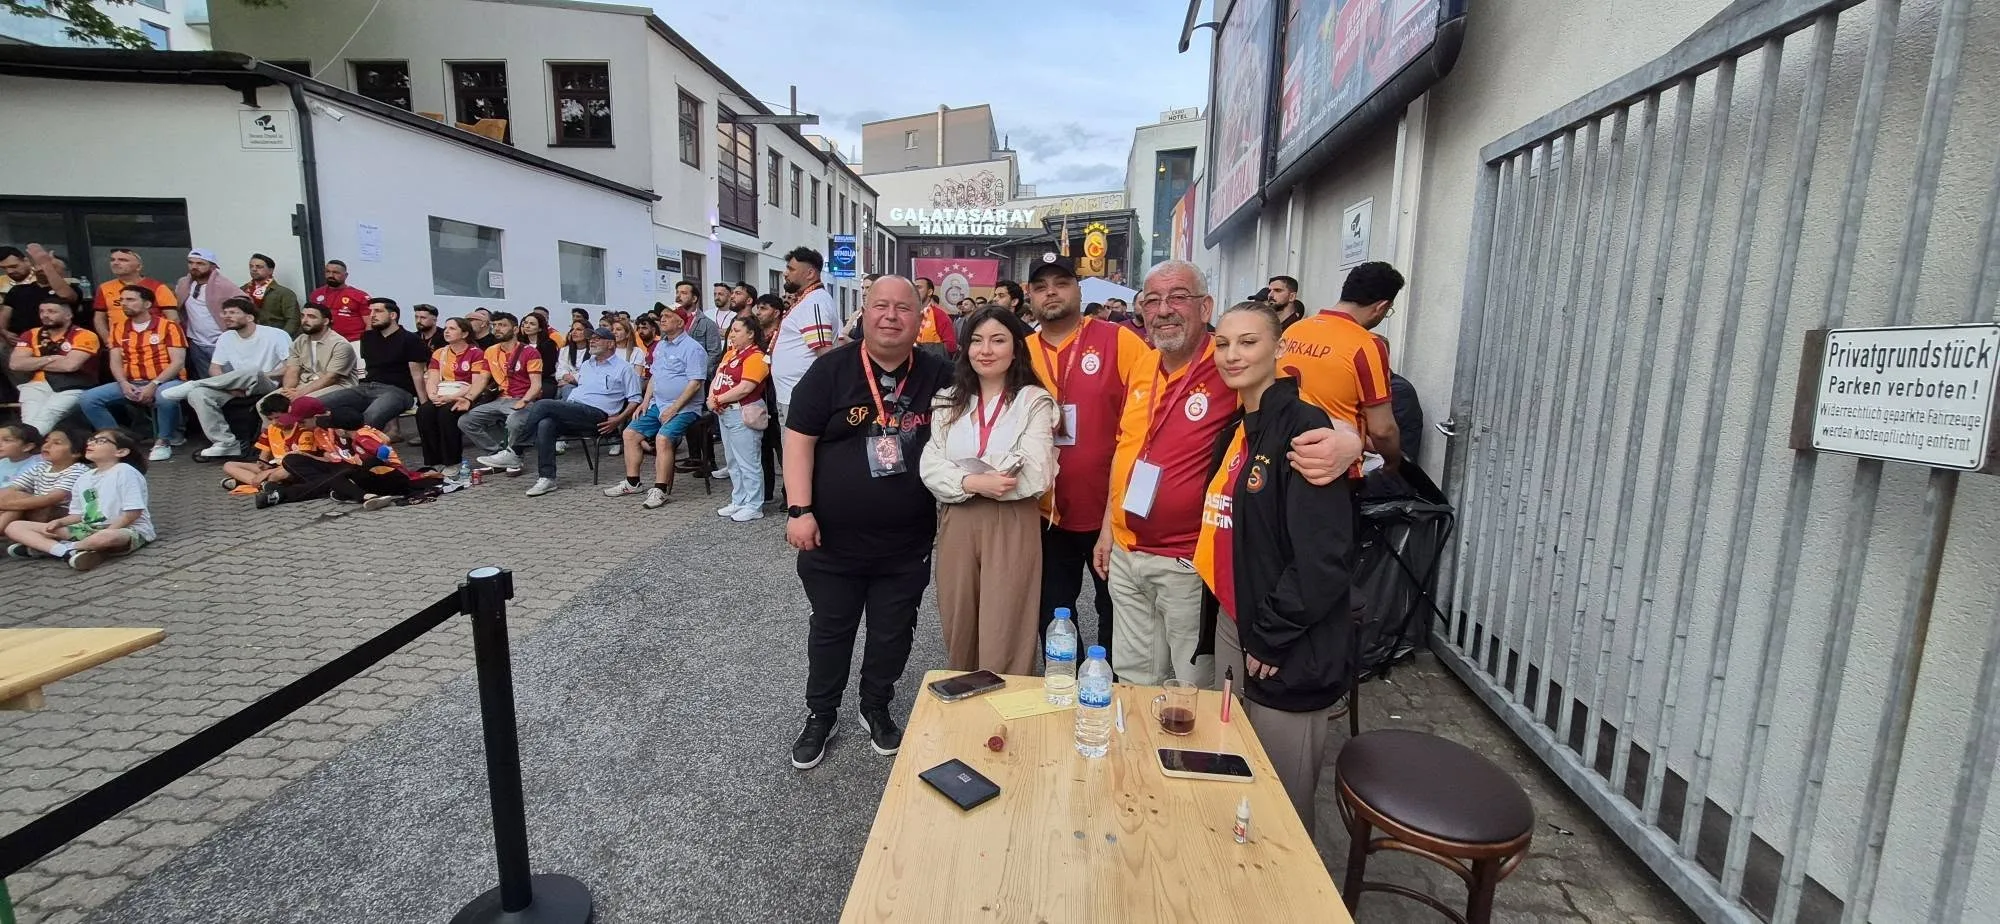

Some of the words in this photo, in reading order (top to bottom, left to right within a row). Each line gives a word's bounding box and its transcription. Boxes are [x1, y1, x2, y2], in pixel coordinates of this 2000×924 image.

[1168, 113, 1187, 121] HOTEL
[889, 207, 1036, 224] GALATASARAY
[919, 220, 1008, 236] HAMBURG
[1827, 338, 1992, 374] Privatgrundstück
[1828, 375, 1881, 396] Parken
[1820, 402, 1882, 420] Widerrechtlich
[1884, 408, 1925, 425] geparkte
[1927, 408, 1982, 431] Fahrzeuge
[1822, 425, 1853, 438] werden
[1854, 426, 1925, 449] kostenpflichtig
[1927, 434, 1971, 451] entfernt
